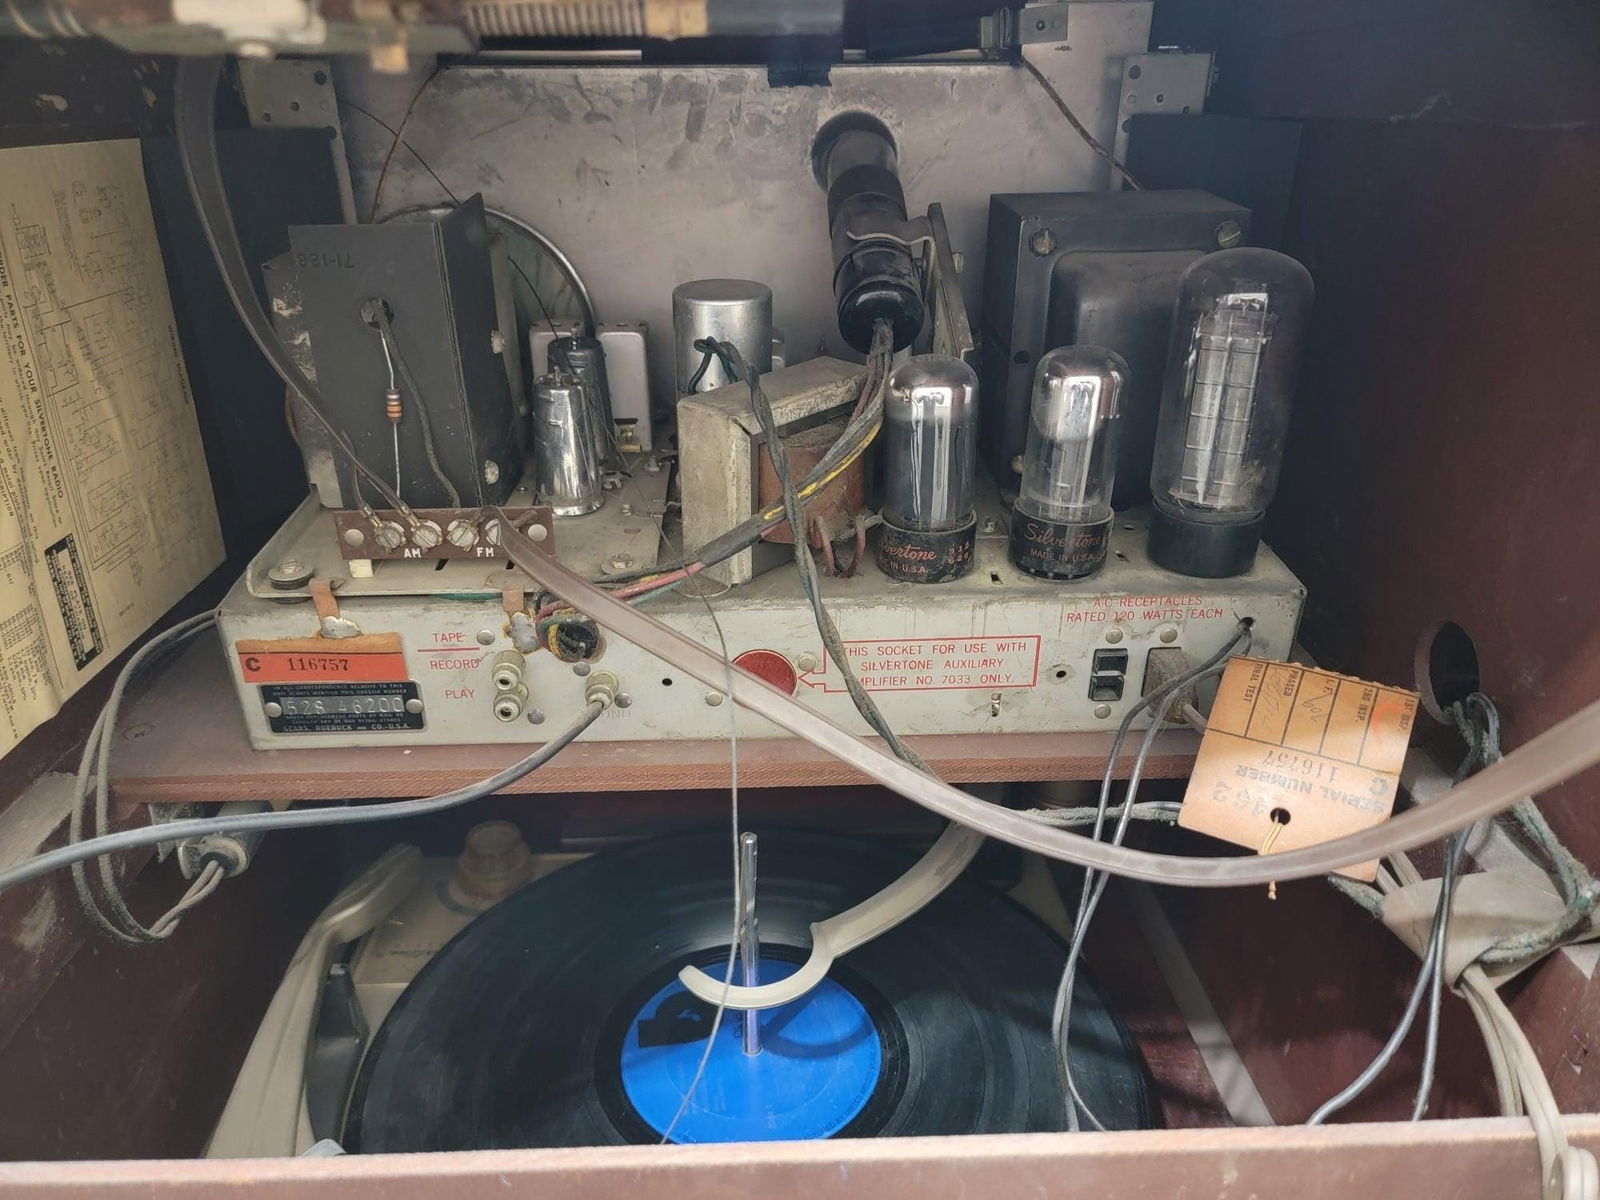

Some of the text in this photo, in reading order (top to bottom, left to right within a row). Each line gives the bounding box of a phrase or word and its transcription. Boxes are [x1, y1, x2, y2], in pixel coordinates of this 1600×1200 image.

[5, 294, 19, 328] PARTS
[15, 334, 26, 356] FOR
[23, 362, 38, 393] YOUR
[34, 398, 54, 460] SILVERTONE
[50, 465, 64, 498] RADIO
[14, 358, 28, 390] ordered
[23, 393, 38, 424] through
[404, 548, 422, 558] AM
[476, 547, 494, 558] FM
[1030, 548, 1056, 560] MADE
[1058, 554, 1069, 562] IN
[1119, 594, 1203, 607] RECEPTACLES
[1066, 608, 1224, 623] RATED 120 WATTS EACH
[432, 633, 464, 643] TAPE
[877, 644, 924, 656] SOCKET
[932, 644, 956, 654] FOR
[964, 643, 988, 654] USE
[996, 642, 1027, 653] WITH
[245, 657, 350, 672] C 116757
[430, 658, 480, 670] RECORD
[861, 658, 1004, 671] SILVERTONE AUXILIARY
[860, 676, 908, 687] MPLIFIER
[942, 674, 971, 685] 7033
[979, 673, 1015, 684] ONLY.
[1242, 662, 1263, 703] FINAL TEST
[1282, 668, 1299, 697] PHASED
[445, 690, 476, 699] PLAY
[1261, 748, 1340, 783] 116757
[1233, 763, 1387, 813] SERIAL NUMBER
